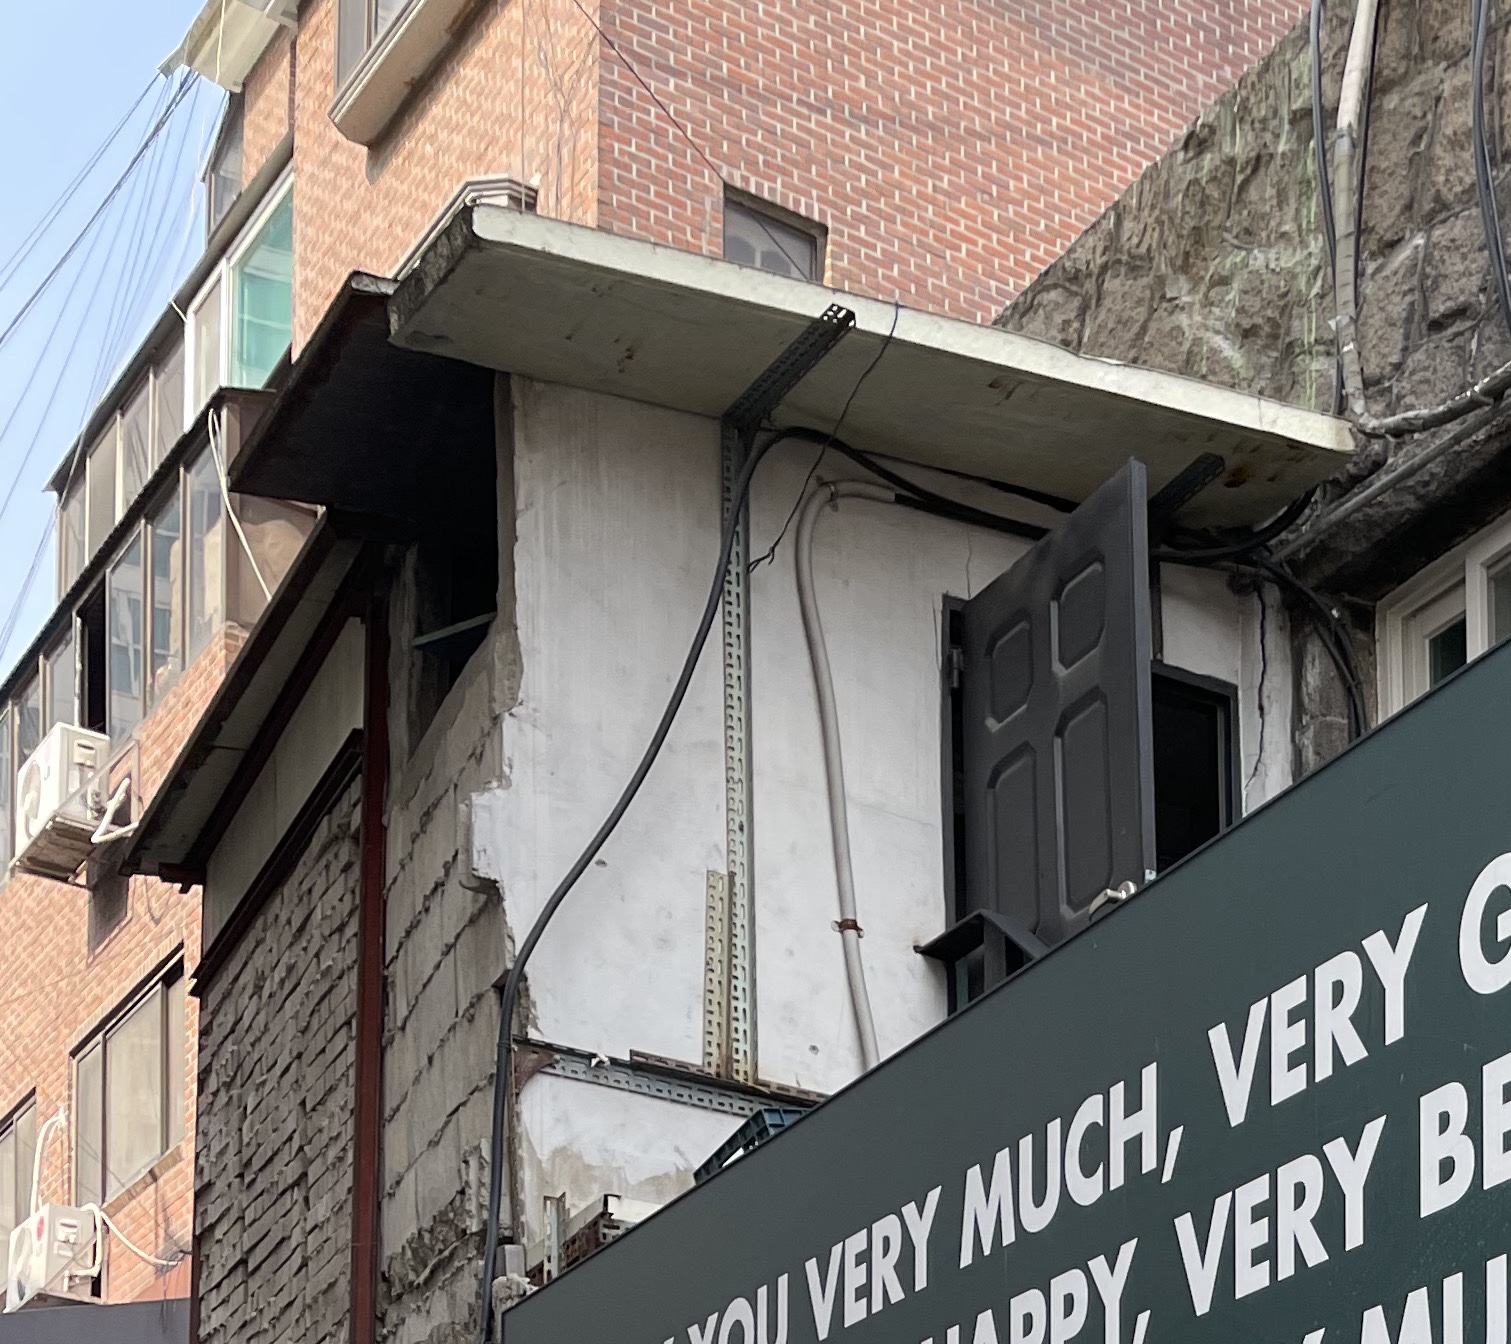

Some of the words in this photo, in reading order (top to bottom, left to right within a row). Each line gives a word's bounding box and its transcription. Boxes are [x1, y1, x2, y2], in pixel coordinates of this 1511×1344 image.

[805, 1184, 943, 1342] VERY
[960, 1061, 1184, 1270] MUCH,
[1208, 902, 1429, 1128] VERY
[1173, 1114, 1387, 1317] VERY
